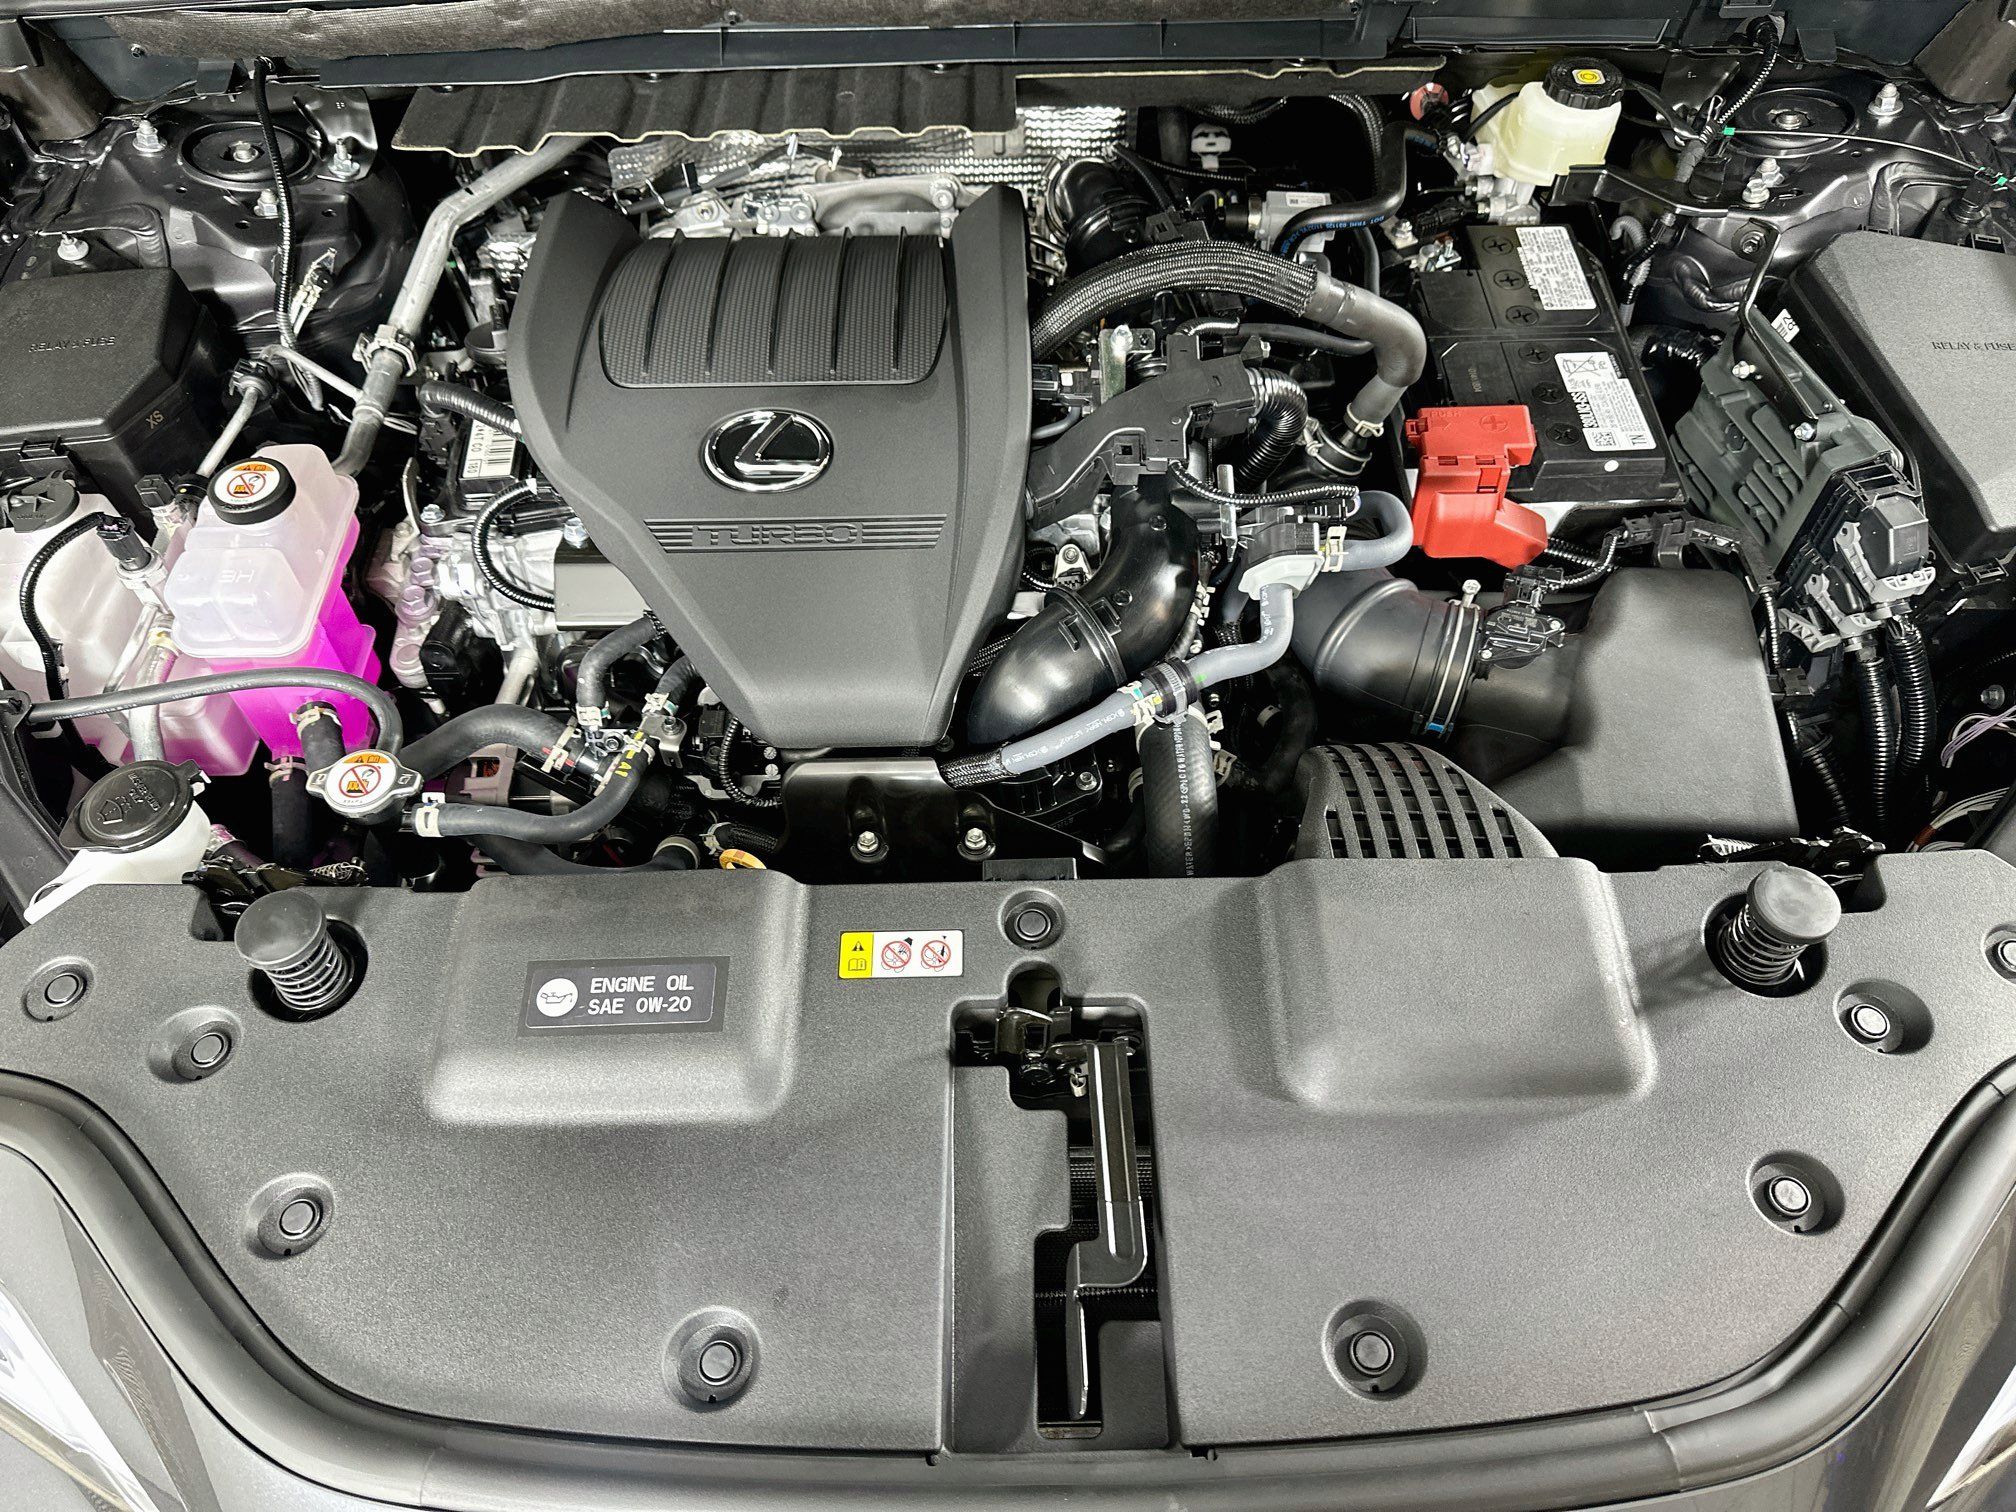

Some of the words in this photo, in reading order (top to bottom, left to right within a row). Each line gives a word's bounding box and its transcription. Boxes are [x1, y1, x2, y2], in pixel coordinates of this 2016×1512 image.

[29, 339, 71, 353] RELAY
[83, 335, 116, 348] FUSE
[1930, 341, 1972, 351] RELAY
[696, 522, 858, 546] TURBO
[590, 975, 656, 994] ENGINE
[666, 974, 695, 991] OIL
[587, 998, 626, 1015] SAE
[635, 995, 692, 1014] 0W-20
